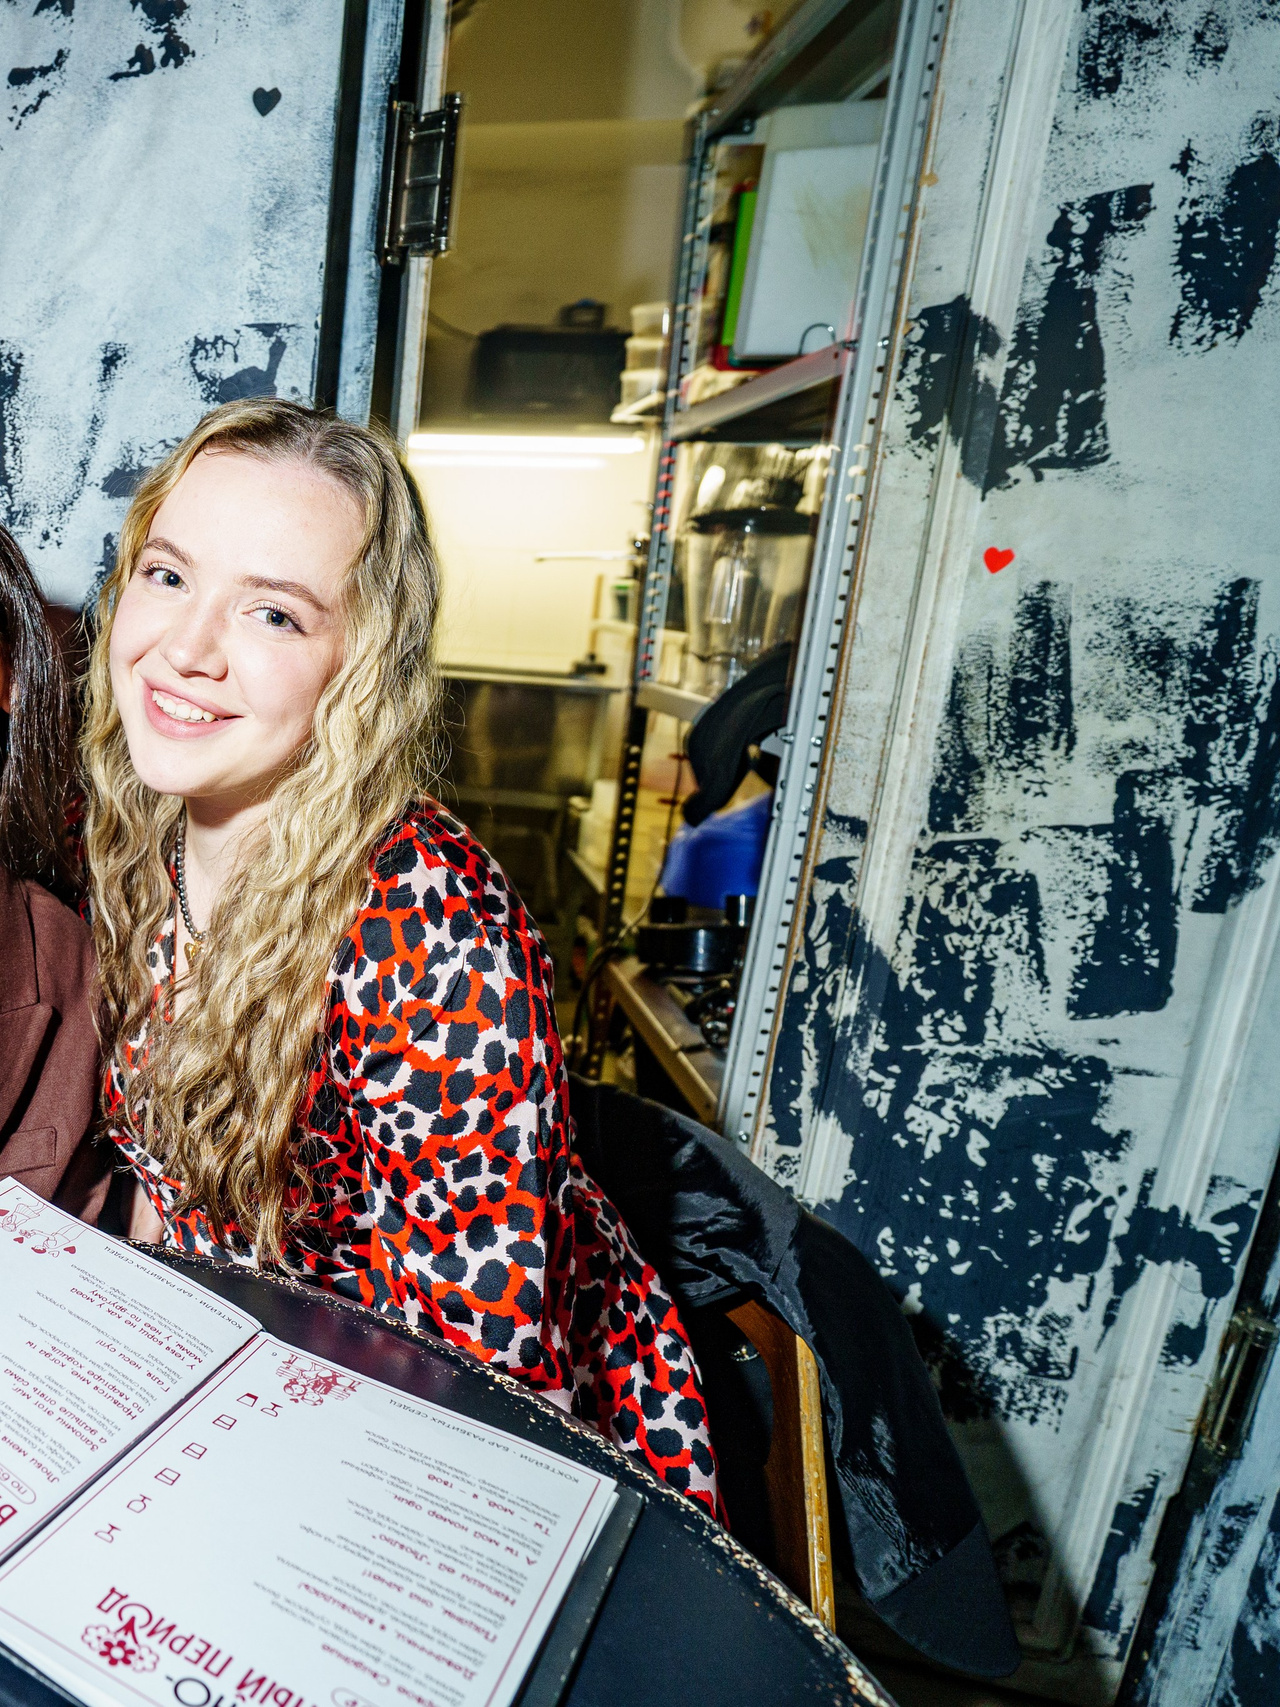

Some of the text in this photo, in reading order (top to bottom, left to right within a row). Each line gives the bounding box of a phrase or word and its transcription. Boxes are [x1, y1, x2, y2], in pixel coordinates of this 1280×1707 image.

[68, 1286, 96, 1303] моей
[101, 1245, 244, 1329] КОКТЕЙЛИ БАР РАЗБИТЫХ СЕРДЕЦ
[103, 1307, 123, 1320] как
[88, 1288, 205, 1363] мамы, у нее по-другому
[122, 1318, 137, 1329] не
[136, 1327, 164, 1346] борщ
[163, 1344, 186, 1361] тебя
[94, 1337, 172, 1392] Галя, неси суп!
[186, 1360, 197, 1370] У
[23, 1339, 138, 1420] Нравится мне, когда ты
[84, 1368, 131, 1402] квартире
[1, 1367, 108, 1444] а дальше опять сама
[130, 1400, 146, 1413] по
[6, 1382, 100, 1452] Запомни этот миг,
[0, 1434, 30, 1458] меня
[387, 1398, 580, 1484] КОКТЕЙЛИ БАР РАЗБИТЫХ СЕРДЕЦ
[27, 1456, 61, 1485] Люби
[425, 1472, 455, 1489] твой
[483, 1497, 515, 1517] мой,
[425, 1508, 469, 1533] номер
[532, 1520, 552, 1536] Ты
[471, 1529, 500, 1548] мой
[503, 1544, 520, 1557] ты
[522, 1554, 538, 1566] А
[436, 1561, 457, 1575] ей
[458, 1571, 517, 1606] Напиши
[407, 1590, 434, 1608] она
[96, 1586, 233, 1678] ПЕРИОД
